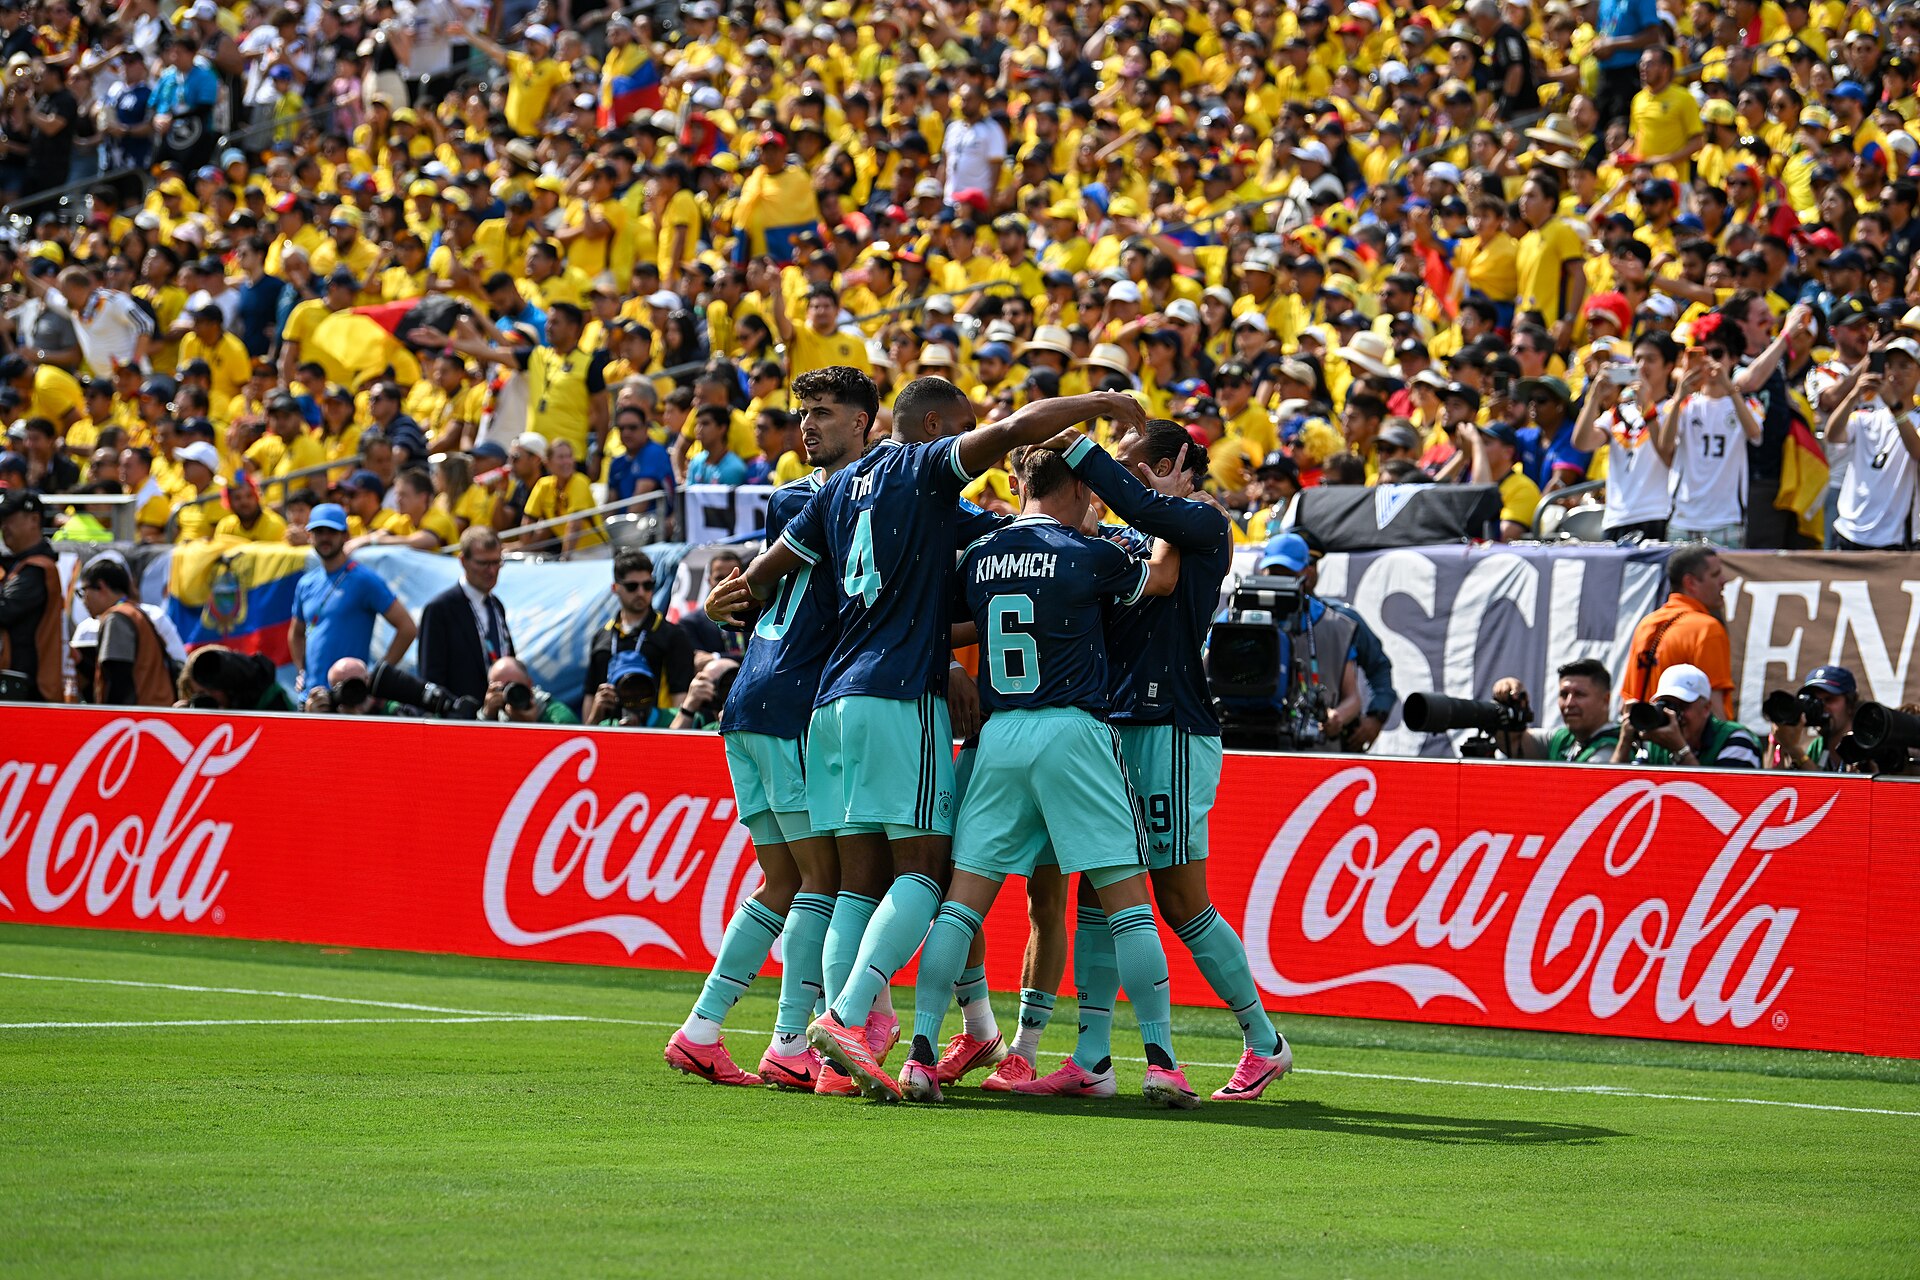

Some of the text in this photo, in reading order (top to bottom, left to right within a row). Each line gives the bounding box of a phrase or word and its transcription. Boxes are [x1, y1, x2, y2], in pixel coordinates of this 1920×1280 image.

[1702, 433, 1726, 458] 13
[843, 508, 883, 609] 4
[975, 552, 1058, 584] KIMMICH
[987, 593, 1041, 695] 6
[1242, 765, 1841, 1029] Coca-Cola
